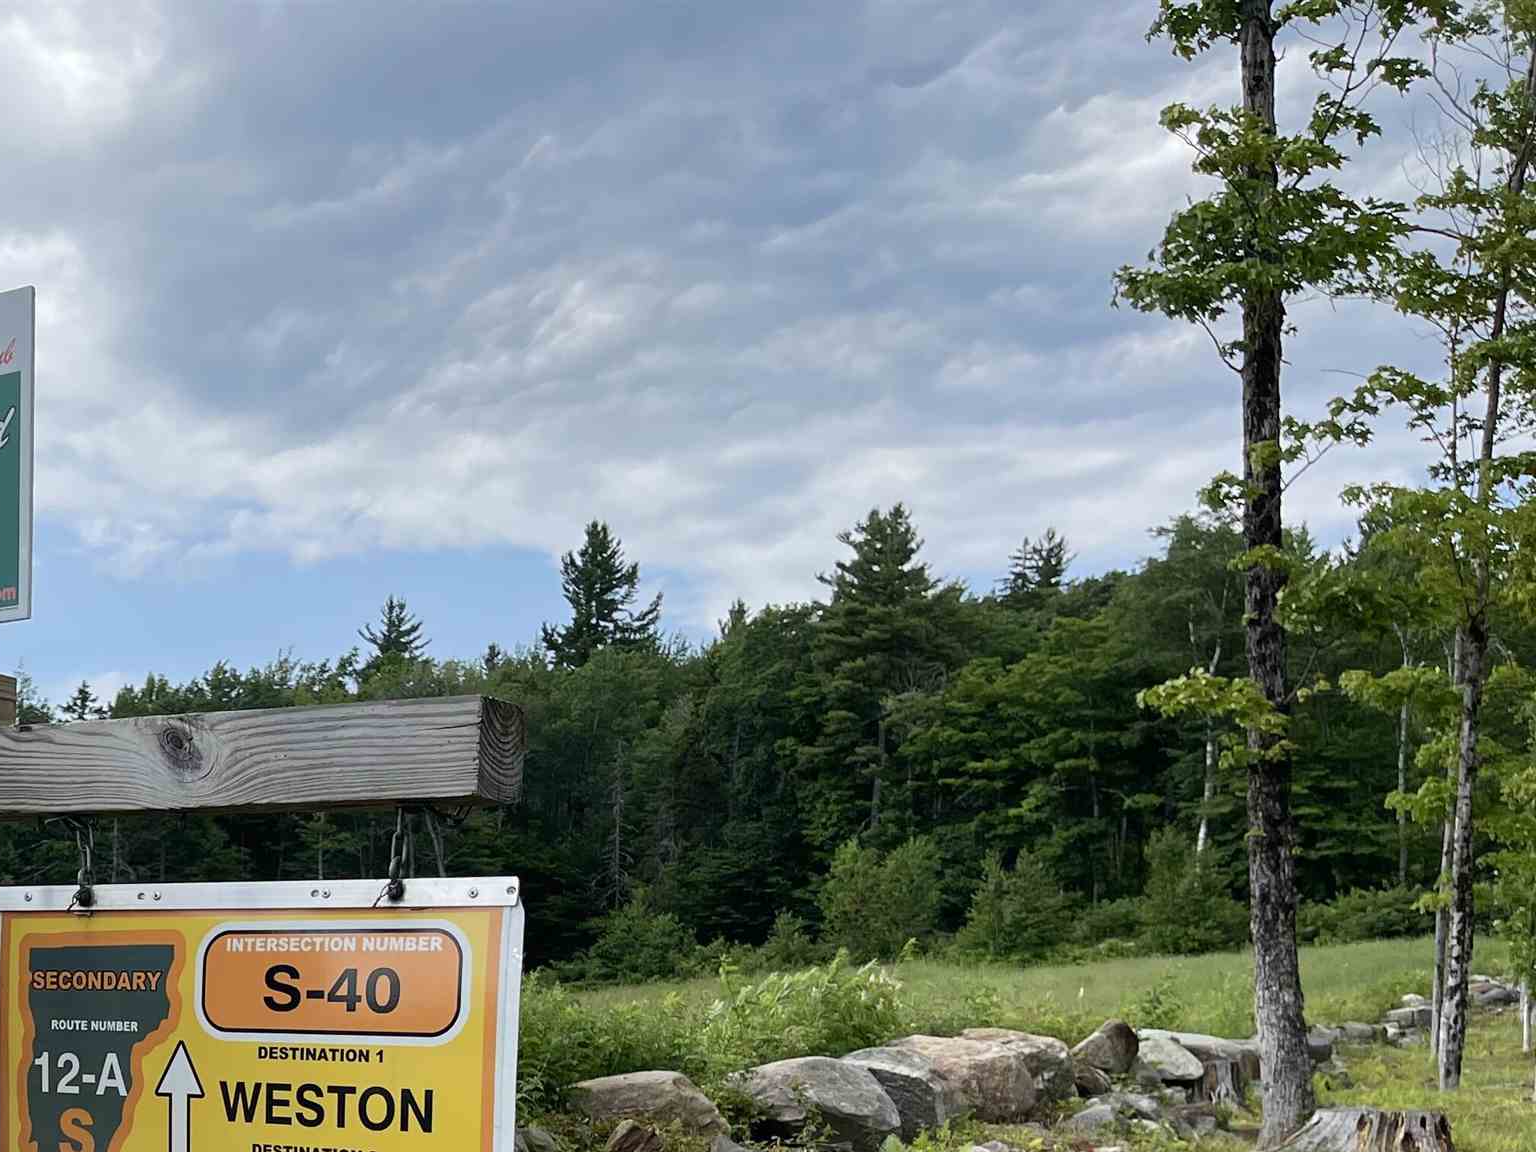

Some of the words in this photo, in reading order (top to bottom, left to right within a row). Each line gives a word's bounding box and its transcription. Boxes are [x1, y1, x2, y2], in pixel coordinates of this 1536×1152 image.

[226, 937, 356, 952] INTERSECTION
[362, 937, 443, 951] NUMBER
[31, 970, 162, 991] SECONDARY
[263, 964, 401, 1014] S-40
[51, 1019, 88, 1031] ROUTE
[91, 1021, 138, 1032] NUMBER
[257, 1046, 370, 1063] DESTINATION
[375, 1050, 384, 1063] 1
[34, 1051, 128, 1096] 12-A
[219, 1080, 434, 1133] WESTON
